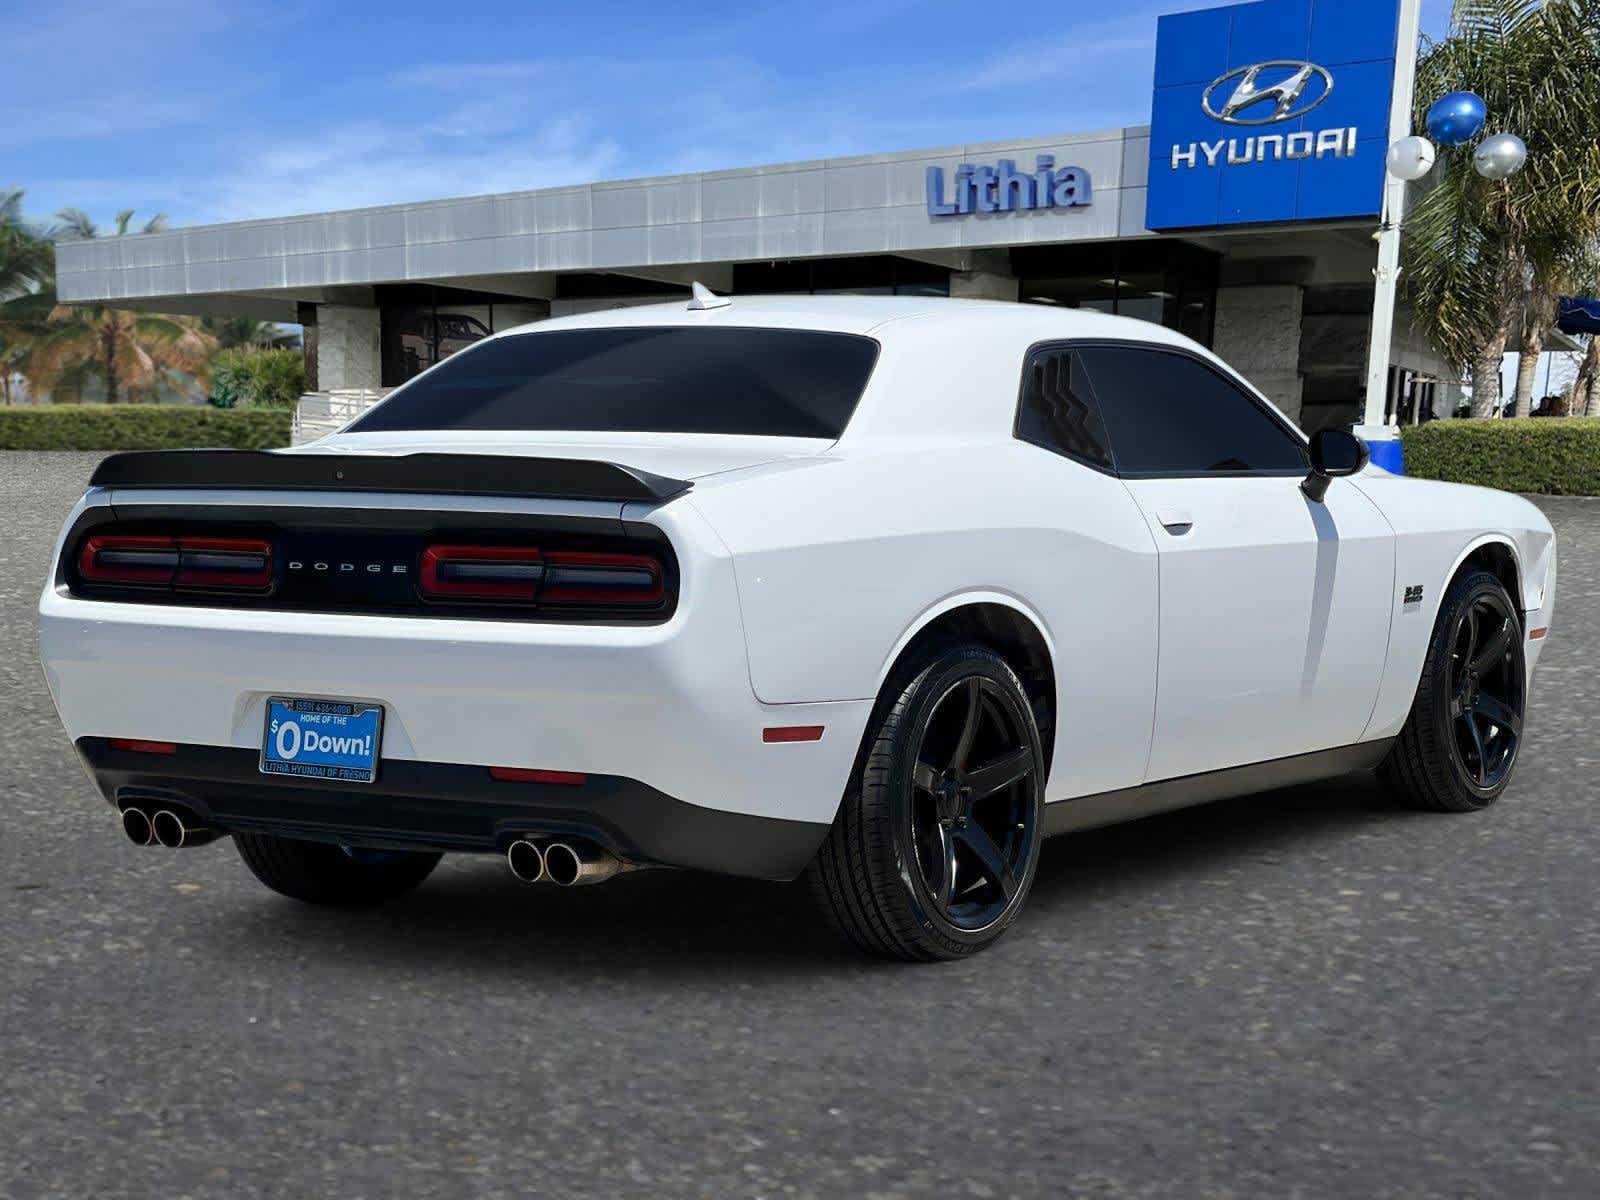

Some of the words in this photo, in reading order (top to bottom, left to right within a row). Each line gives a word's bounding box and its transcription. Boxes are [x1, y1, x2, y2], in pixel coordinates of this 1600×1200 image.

[1171, 127, 1357, 169] HYUNDAI
[925, 155, 1092, 217] Lithia
[289, 562, 407, 573] DODGE
[300, 714, 321, 724] HOME
[322, 715, 331, 724] OF
[333, 716, 347, 726] THE
[303, 730, 371, 756] Down!
[265, 762, 289, 772] LITHIA
[291, 765, 326, 777] HYUNDAI
[327, 768, 338, 777] OF
[339, 769, 370, 780] FRESNO
